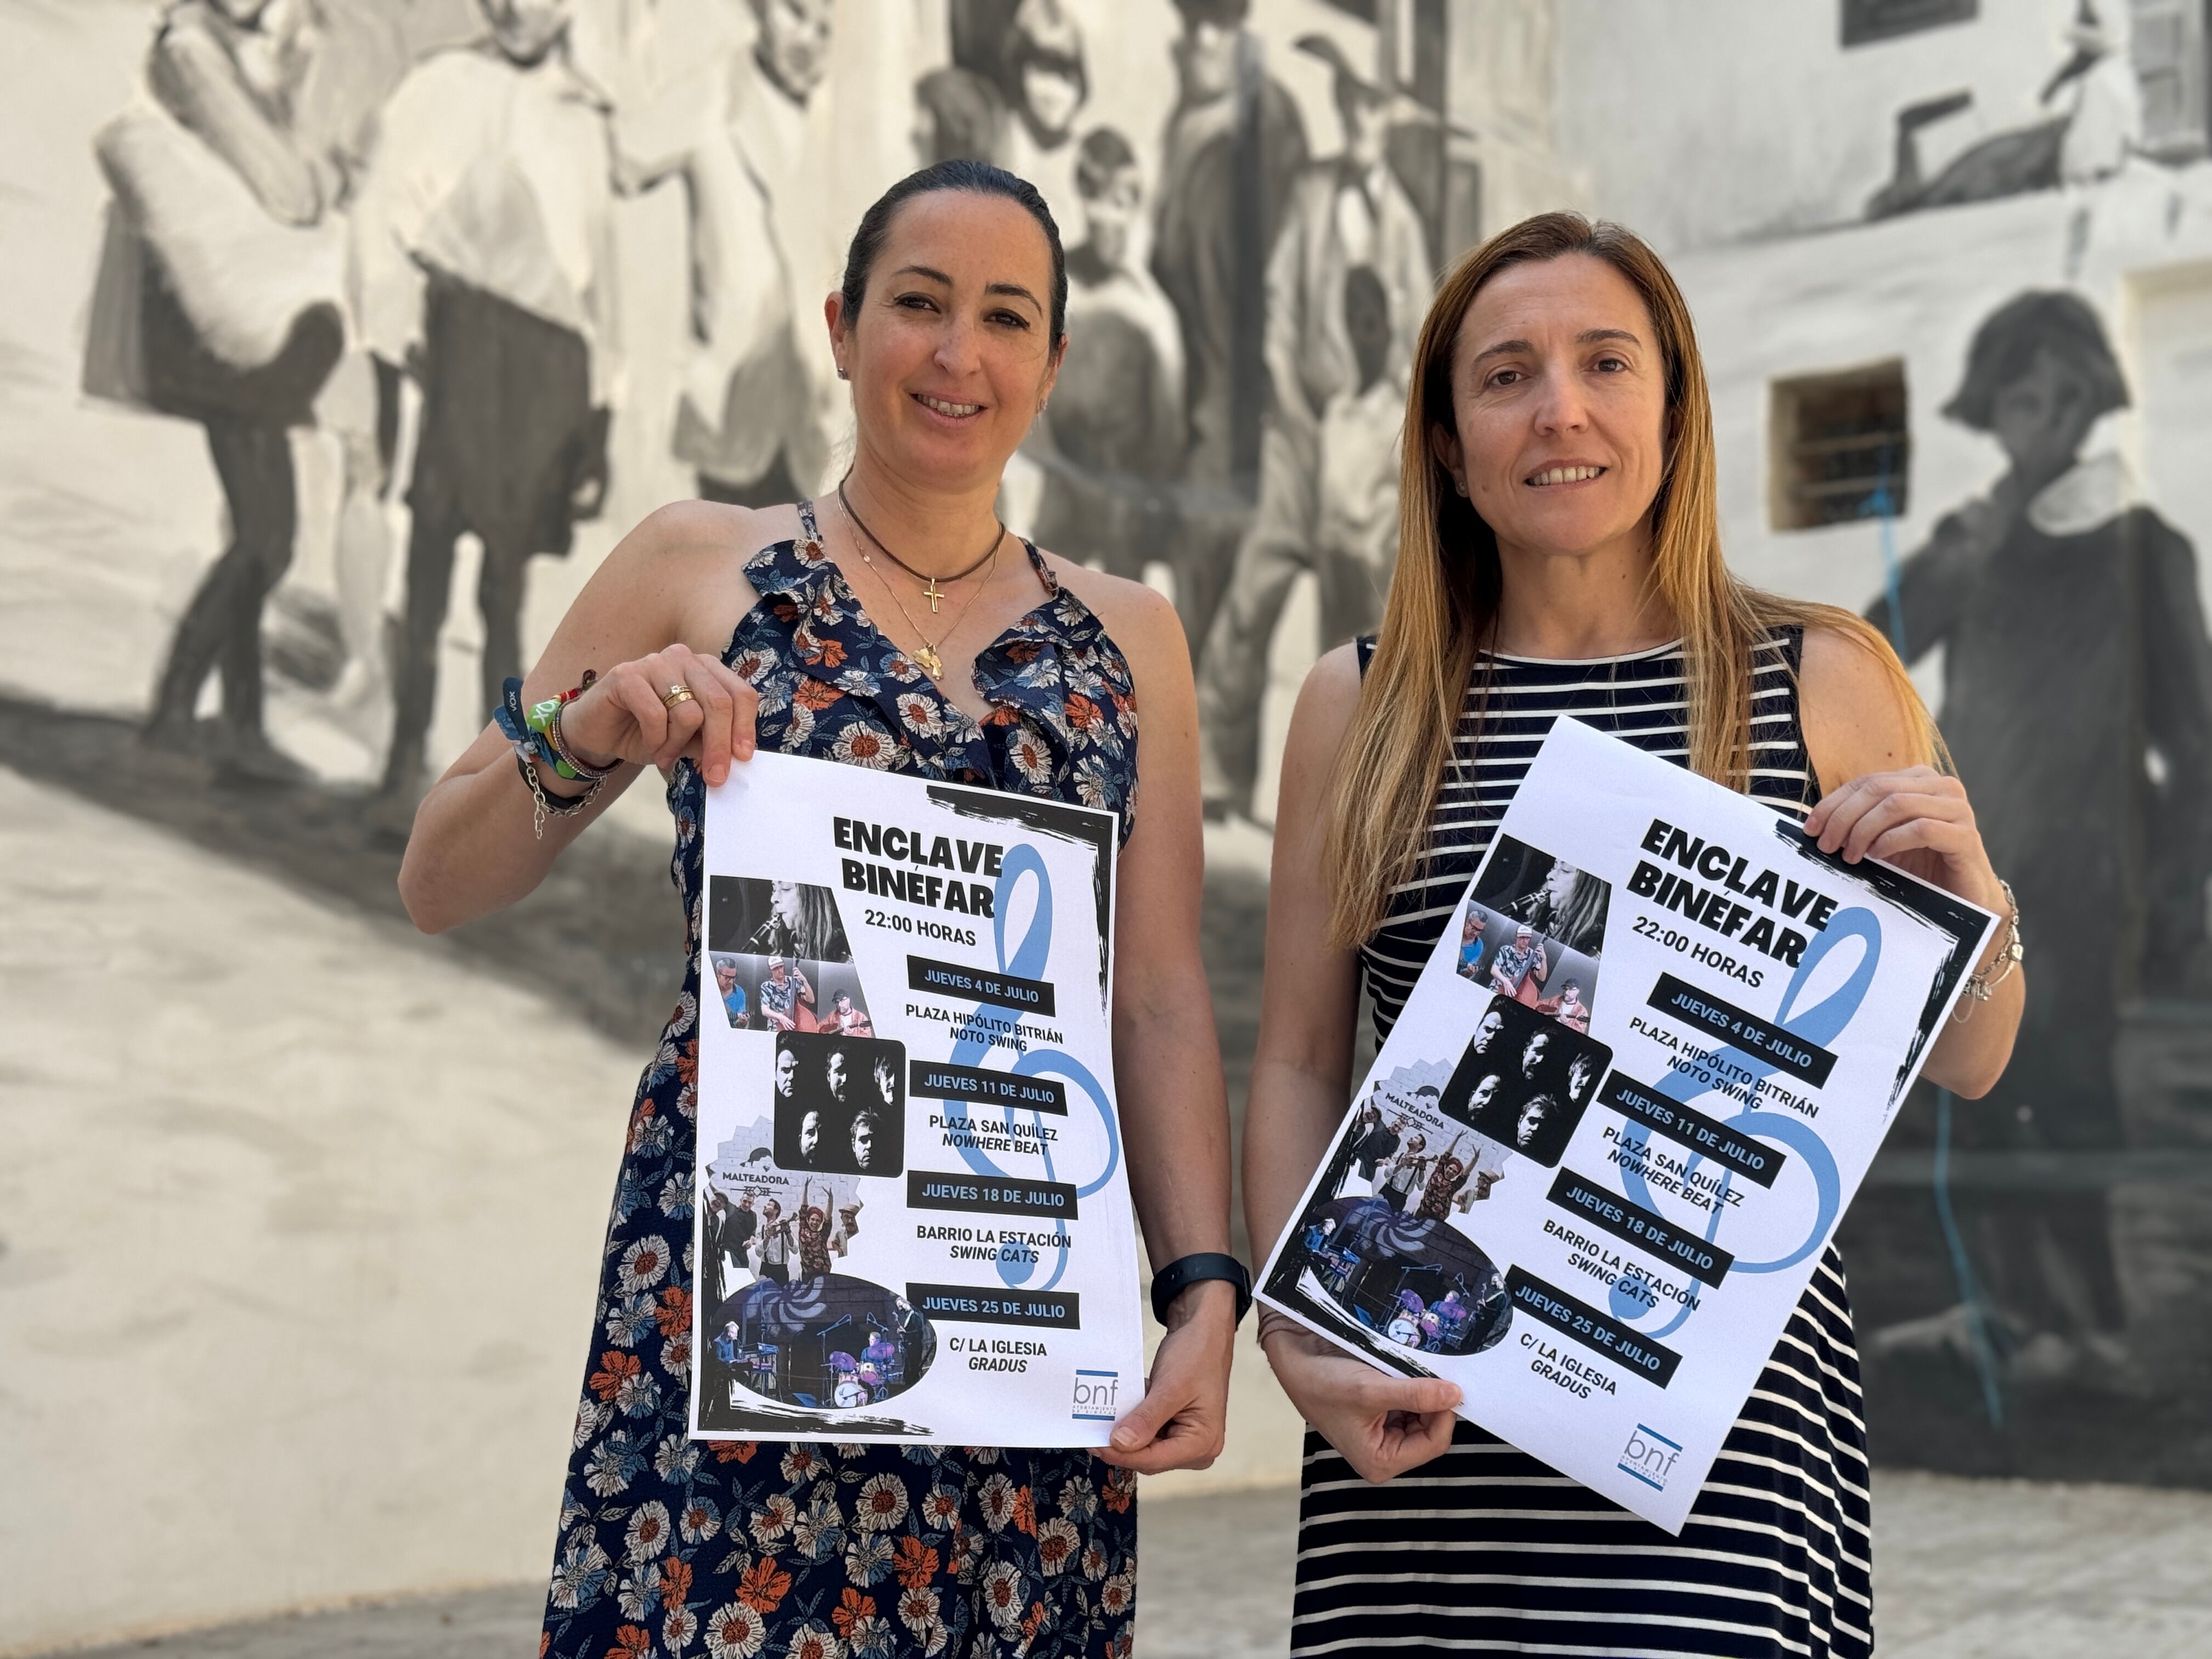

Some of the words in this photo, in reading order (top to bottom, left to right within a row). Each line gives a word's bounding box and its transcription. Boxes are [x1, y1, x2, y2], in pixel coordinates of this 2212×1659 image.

[834, 816, 1003, 878] ENCLAVE
[842, 858, 995, 918] BINÉFAR
[1640, 818, 1838, 932] ENCLAVE
[865, 910, 912, 933] 22:00
[917, 920, 975, 946] HORAS
[1626, 860, 1808, 968] BINÉFAR
[1632, 916, 1689, 952] 22:00
[1691, 943, 1764, 988] HORAS
[925, 969, 972, 989] JUEVES
[975, 980, 983, 992] 4
[986, 981, 1001, 996] DE
[1005, 986, 1039, 1003] JULIO
[906, 1005, 950, 1022] PLAZA
[953, 1012, 1011, 1034] HIPÓLITO
[1015, 1024, 1063, 1044] BITRIÁN
[950, 1027, 984, 1043] NOTO
[988, 1034, 1027, 1051] SWING
[1671, 993, 1730, 1028] JUEVES
[1731, 1022, 1741, 1034] 4
[1743, 1026, 1763, 1046] DE
[1766, 1036, 1812, 1068] JULIO
[924, 1074, 978, 1091] JUEVES
[981, 1081, 995, 1094] 11
[1001, 1083, 1017, 1097] DE
[1020, 1087, 1054, 1104] JULIO
[1629, 1017, 1677, 1050] PLAZA
[1682, 1042, 1753, 1085] HIPÓLITO
[1755, 1079, 1820, 1119] BITRIÁN
[1667, 1056, 1711, 1084] NOTO
[1712, 1077, 1763, 1110] SWING
[930, 1115, 977, 1131] PLAZA
[981, 1120, 1009, 1134] SAN
[1013, 1122, 1058, 1141] QUÍLEZ
[1385, 1092, 1444, 1130] MALTEADORA
[1616, 1089, 1674, 1124] JUEVES
[1677, 1119, 1694, 1136] 11
[1700, 1127, 1719, 1148] DE
[1718, 1137, 1765, 1170] JULIO
[943, 1133, 1011, 1152] NOWHERE
[1015, 1141, 1047, 1155] BEAT
[723, 1172, 789, 1185] MALTEADORA
[1602, 1126, 1651, 1160] PLAZA
[1655, 1154, 1688, 1178] SAN
[1690, 1172, 1745, 1206] QUÍLEZ
[1607, 1149, 1683, 1194] NOWHERE
[1681, 1188, 1724, 1214] BEAT
[922, 1184, 978, 1200] JUEVES
[983, 1188, 999, 1201] 18
[1004, 1190, 1022, 1204] DE
[1025, 1192, 1064, 1207] JULIO
[917, 1226, 972, 1242] BARRIO
[977, 1229, 995, 1243] LA
[999, 1231, 1071, 1248] ESTACIÓN
[1566, 1186, 1624, 1223] JUEVES
[1626, 1216, 1644, 1234] 18
[1645, 1225, 1668, 1247] DE
[1668, 1239, 1713, 1270] JULIO
[950, 1246, 997, 1261] SWING
[1001, 1249, 1039, 1263] CATS
[1543, 1220, 1599, 1257] BARRIO
[1601, 1249, 1621, 1270] LA
[1623, 1263, 1701, 1311] ESTACIÓN
[1568, 1252, 1617, 1286] SWING
[1616, 1279, 1660, 1308] CATS
[922, 1297, 978, 1313] JUEVES
[981, 1301, 998, 1314] 25
[1003, 1302, 1022, 1315] DE
[1025, 1304, 1065, 1318] JULIO
[1515, 1285, 1572, 1323] JUEVES
[1572, 1315, 1593, 1335] 25
[1593, 1325, 1616, 1347] DE
[1616, 1340, 1661, 1372] JULIO
[950, 1338, 966, 1352] C/
[969, 1339, 988, 1353] LA
[992, 1340, 1047, 1356] IGLESIA
[969, 1357, 1028, 1373] GRADUS
[1520, 1333, 1539, 1350] C/
[1537, 1342, 1556, 1363] LA
[1560, 1353, 1617, 1396] IGLESIA
[1073, 1378, 1118, 1406] bnf
[1530, 1359, 1592, 1399] GRADUS
[1624, 1430, 1680, 1476] bnf
